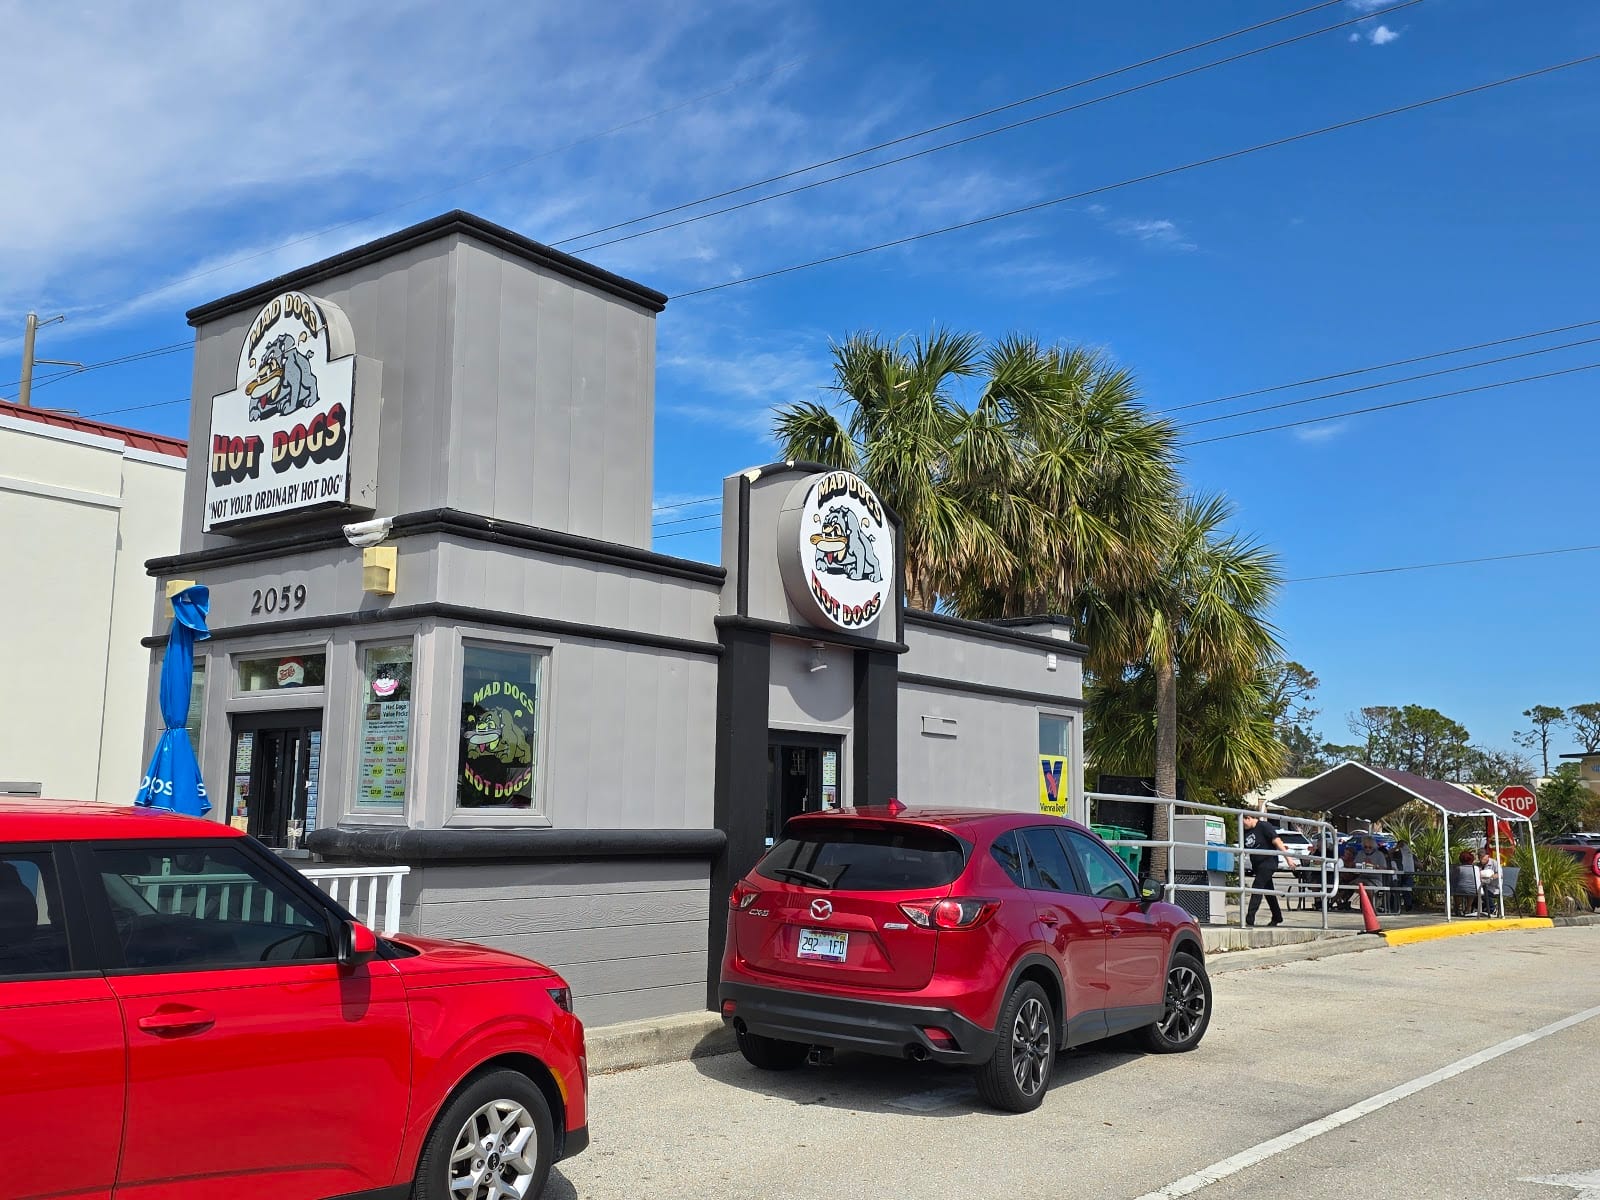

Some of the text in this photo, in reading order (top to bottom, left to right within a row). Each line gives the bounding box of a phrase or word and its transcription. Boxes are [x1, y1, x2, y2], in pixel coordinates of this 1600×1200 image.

[248, 294, 319, 358] MAD DOGS
[212, 402, 346, 487] HOT DOGS
[230, 494, 252, 515] YOUR
[255, 484, 299, 511] ORDINARY
[301, 479, 319, 501] HOT
[818, 473, 883, 528] MAD DOGS
[251, 584, 307, 616] 2059
[812, 570, 881, 625] HOT DOGS
[473, 681, 534, 715] MAD DOGS
[465, 762, 532, 798] HOT DOGS
[1500, 797, 1534, 810] STOP
[801, 936, 819, 952] 292
